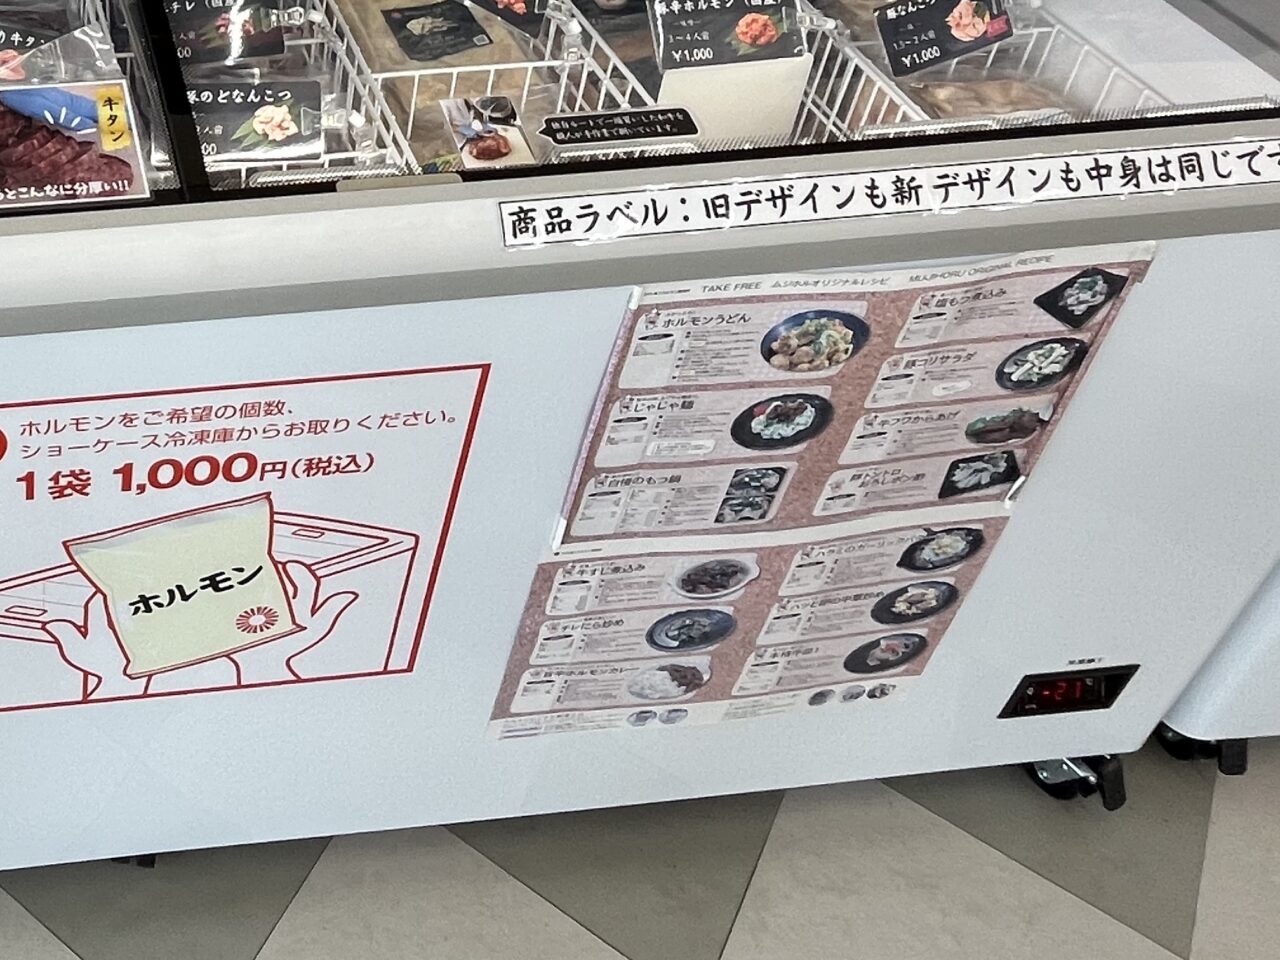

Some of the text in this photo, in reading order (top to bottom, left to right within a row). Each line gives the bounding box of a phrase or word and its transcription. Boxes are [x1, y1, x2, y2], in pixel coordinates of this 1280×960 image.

[101, 95, 125, 144] 牛タン
[663, 313, 752, 329] ホルモンうどん
[21, 409, 457, 459] ショーケース冷凍庫からお取りください。
[16, 467, 92, 501] 1袋
[129, 563, 264, 616] ホルモン
